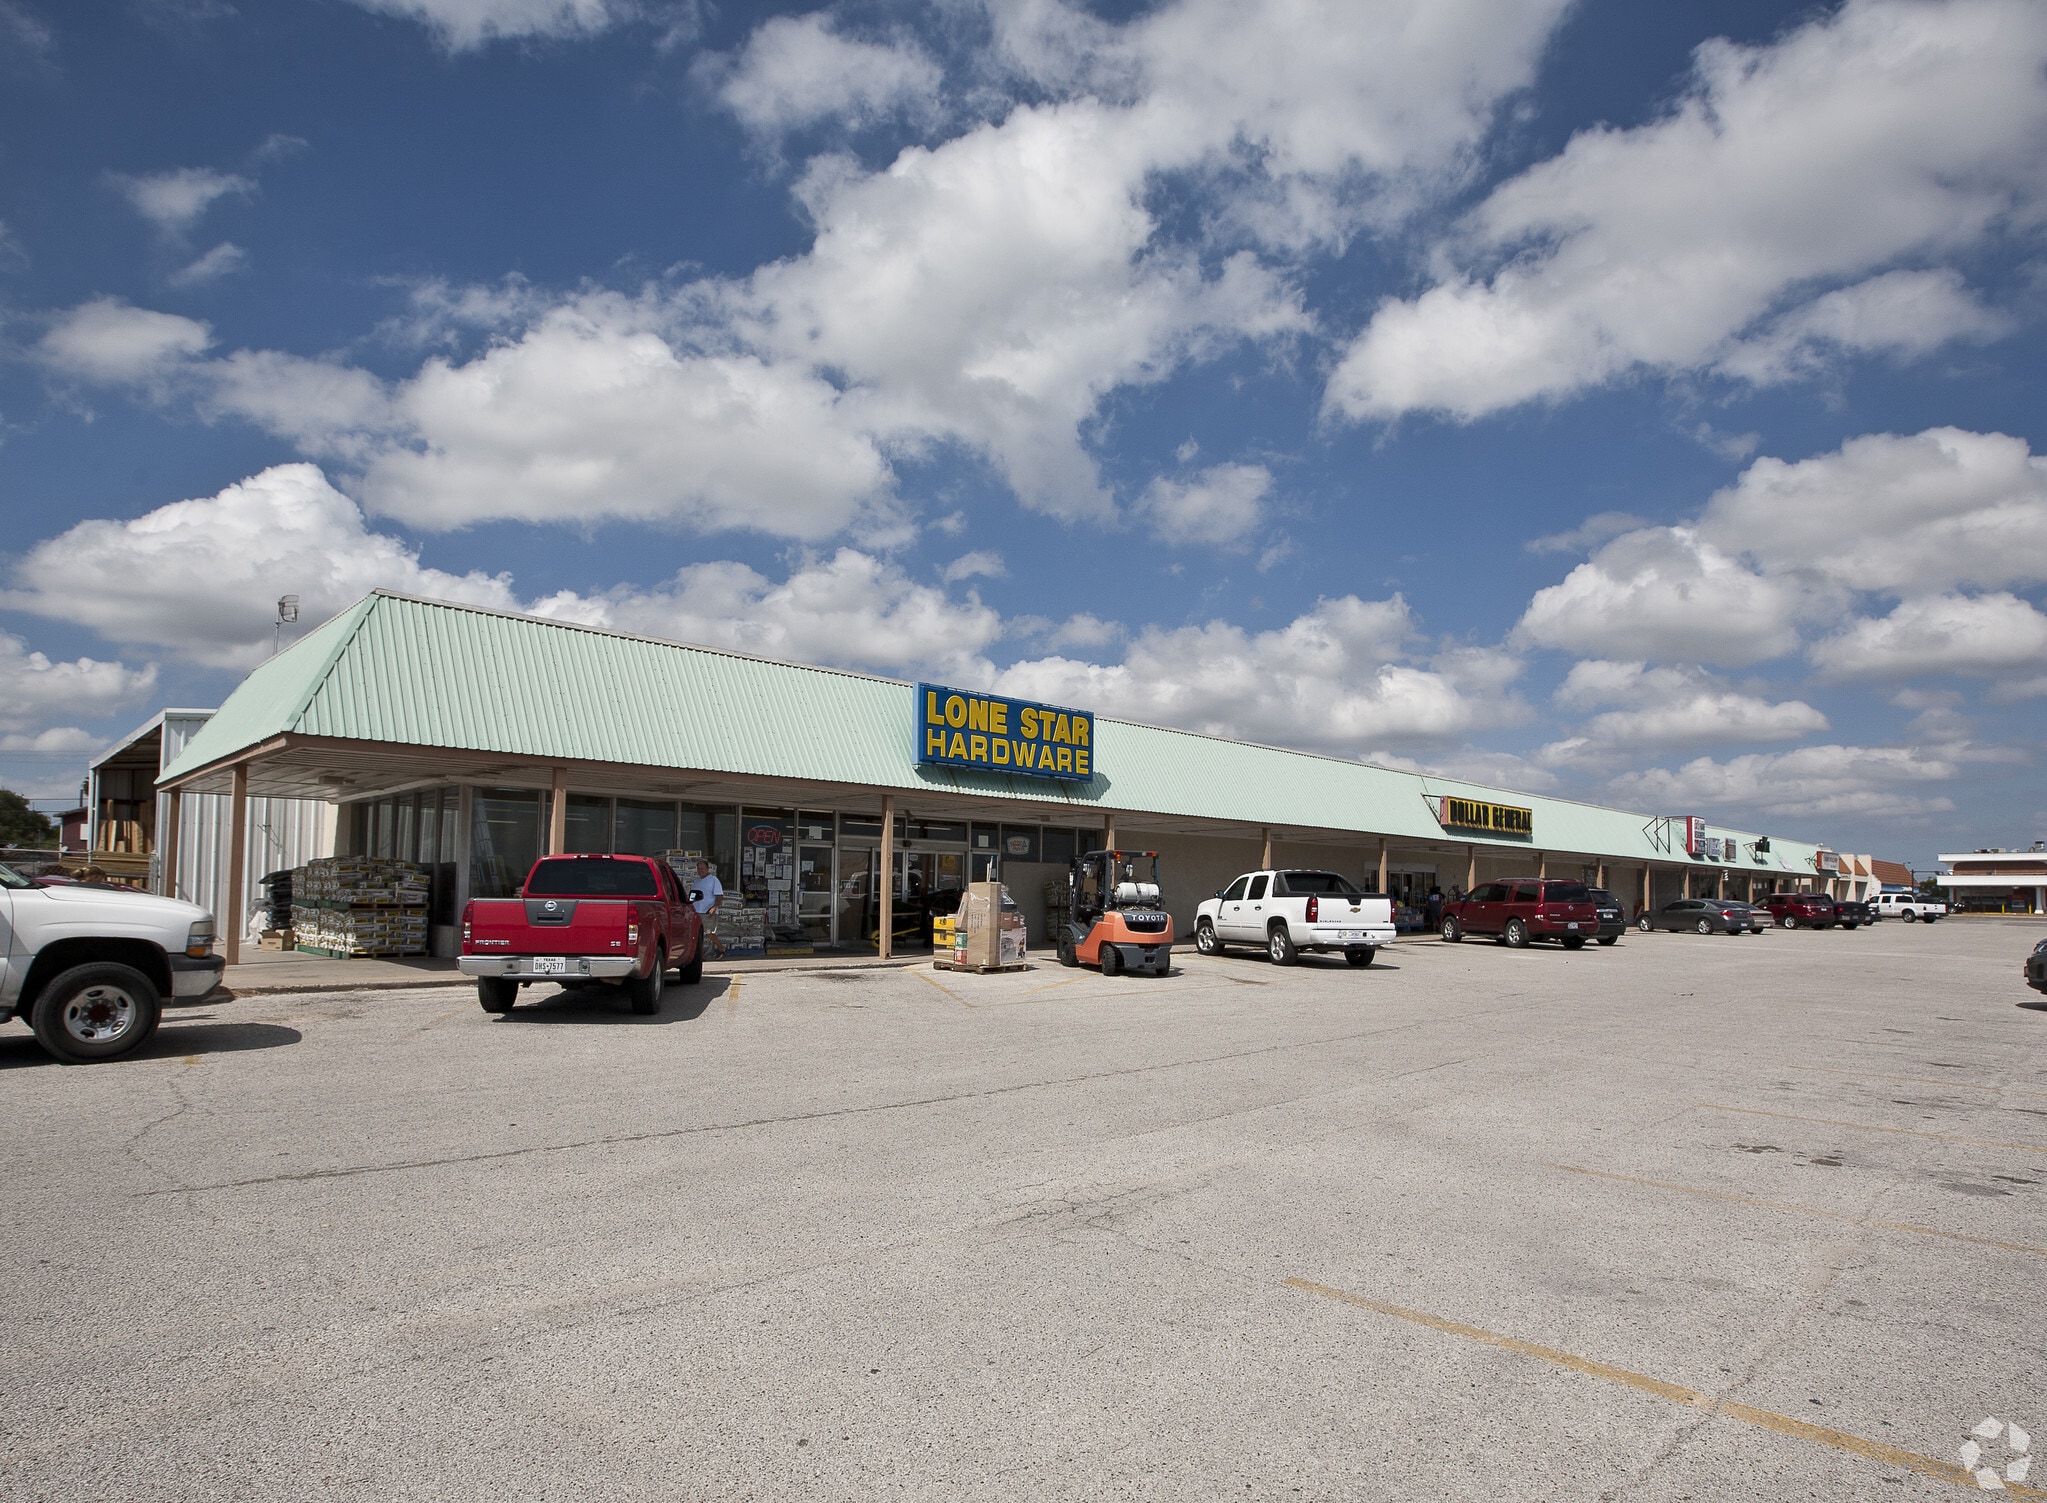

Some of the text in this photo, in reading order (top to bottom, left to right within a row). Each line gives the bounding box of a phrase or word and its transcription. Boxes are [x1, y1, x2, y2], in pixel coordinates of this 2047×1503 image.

[927, 691, 1090, 747] LONE STAR
[926, 728, 1089, 775] HARDWARE
[1450, 799, 1533, 832] DOLLAR GENERAL
[747, 828, 781, 845] OPEN
